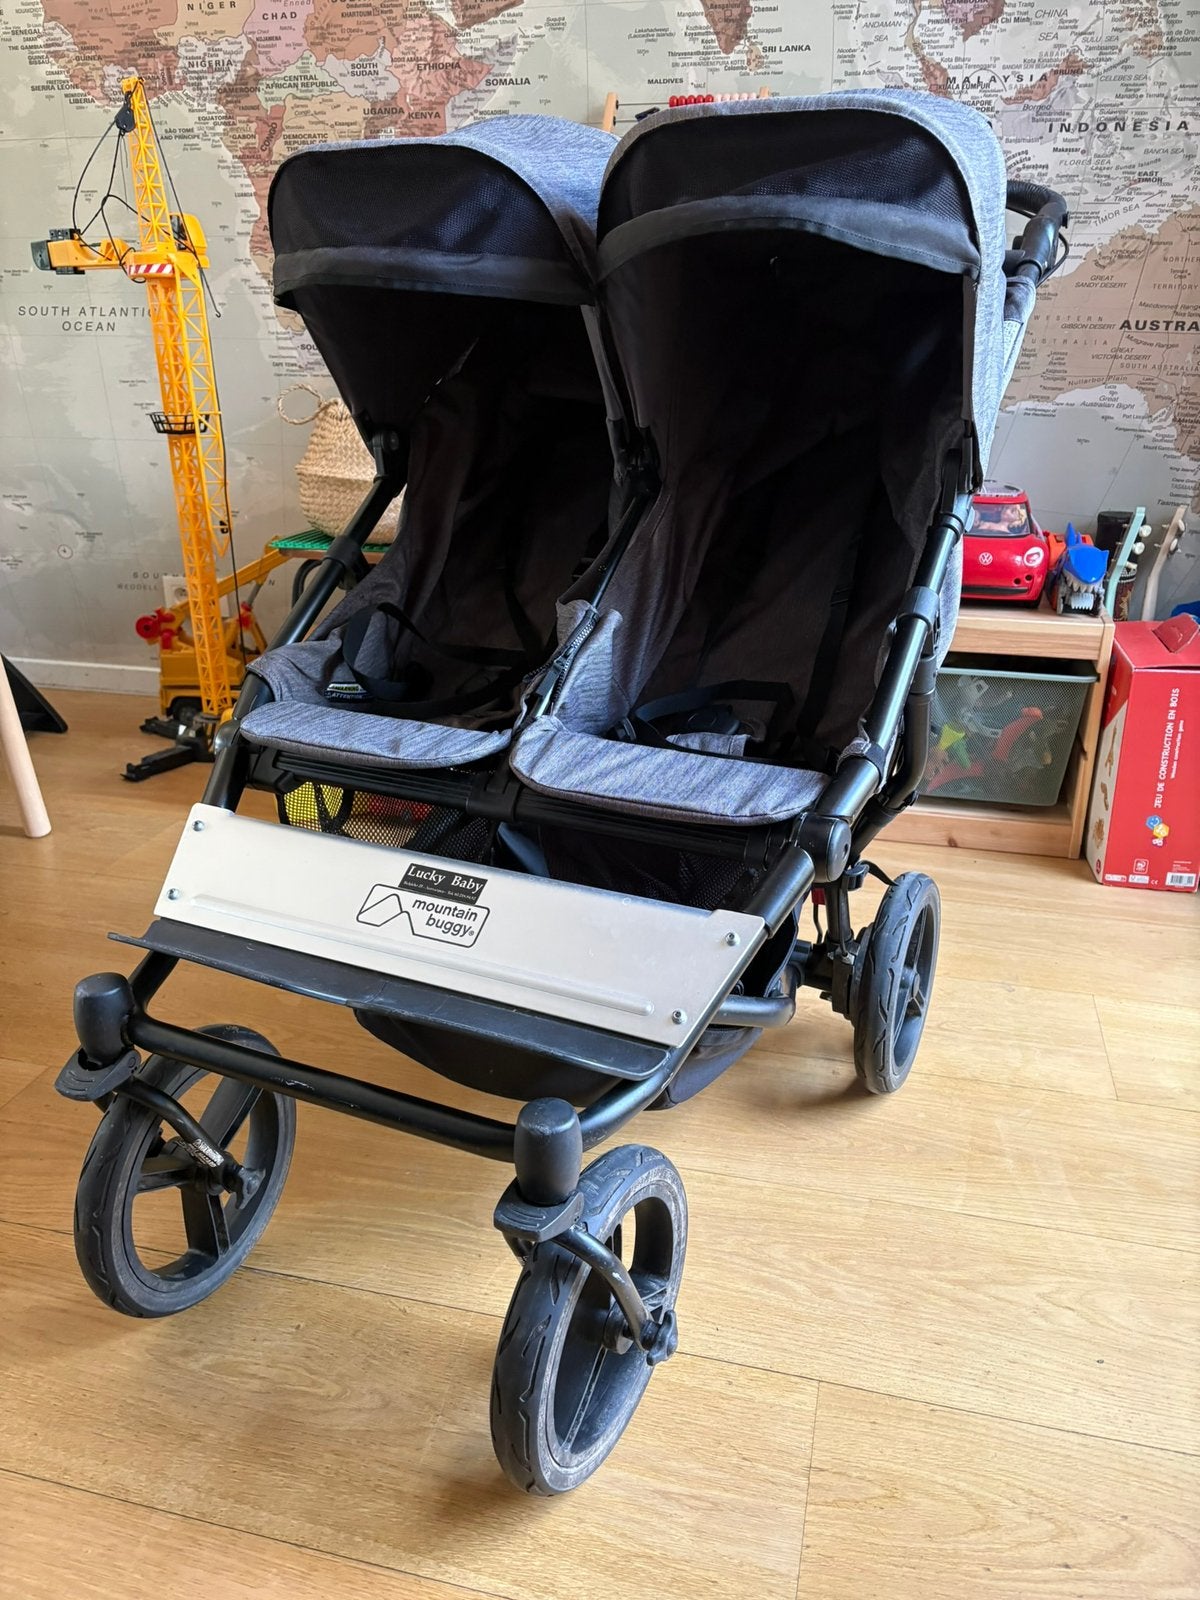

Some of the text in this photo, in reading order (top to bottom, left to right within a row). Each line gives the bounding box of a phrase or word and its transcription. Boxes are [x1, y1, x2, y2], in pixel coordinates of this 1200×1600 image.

[187, 2, 236, 10] NIGER
[262, 12, 297, 20] CHAD
[1034, 9, 1068, 18] CHINA
[862, 20, 902, 29] ANDAMAN
[1038, 32, 1059, 41] SEA
[188, 60, 233, 68] NIGERIA
[417, 62, 461, 71] ETHIOPIA
[485, 78, 531, 86] SOMALIA
[946, 73, 1048, 84] MALAYSIA
[217, 86, 260, 94] CAMEROON
[265, 81, 298, 90] AFRICAN
[363, 107, 405, 115] UGANDA
[408, 112, 441, 120] KENYA
[1049, 121, 1189, 132] INDONESIA
[260, 122, 277, 152] CONGO
[1123, 203, 1140, 213] SEA
[18, 305, 70, 316] SOUTH
[62, 321, 116, 332] OCEAN
[1119, 320, 1200, 332] AUSTRA
[1068, 377, 1104, 386] Nullarbor
[1080, 401, 1135, 411] Australian Bight
[1154, 688, 1180, 808] JEU DE CONSTRUCTION EN BOIS
[407, 866, 484, 894] Lucky Baby
[412, 899, 478, 922] mountain
